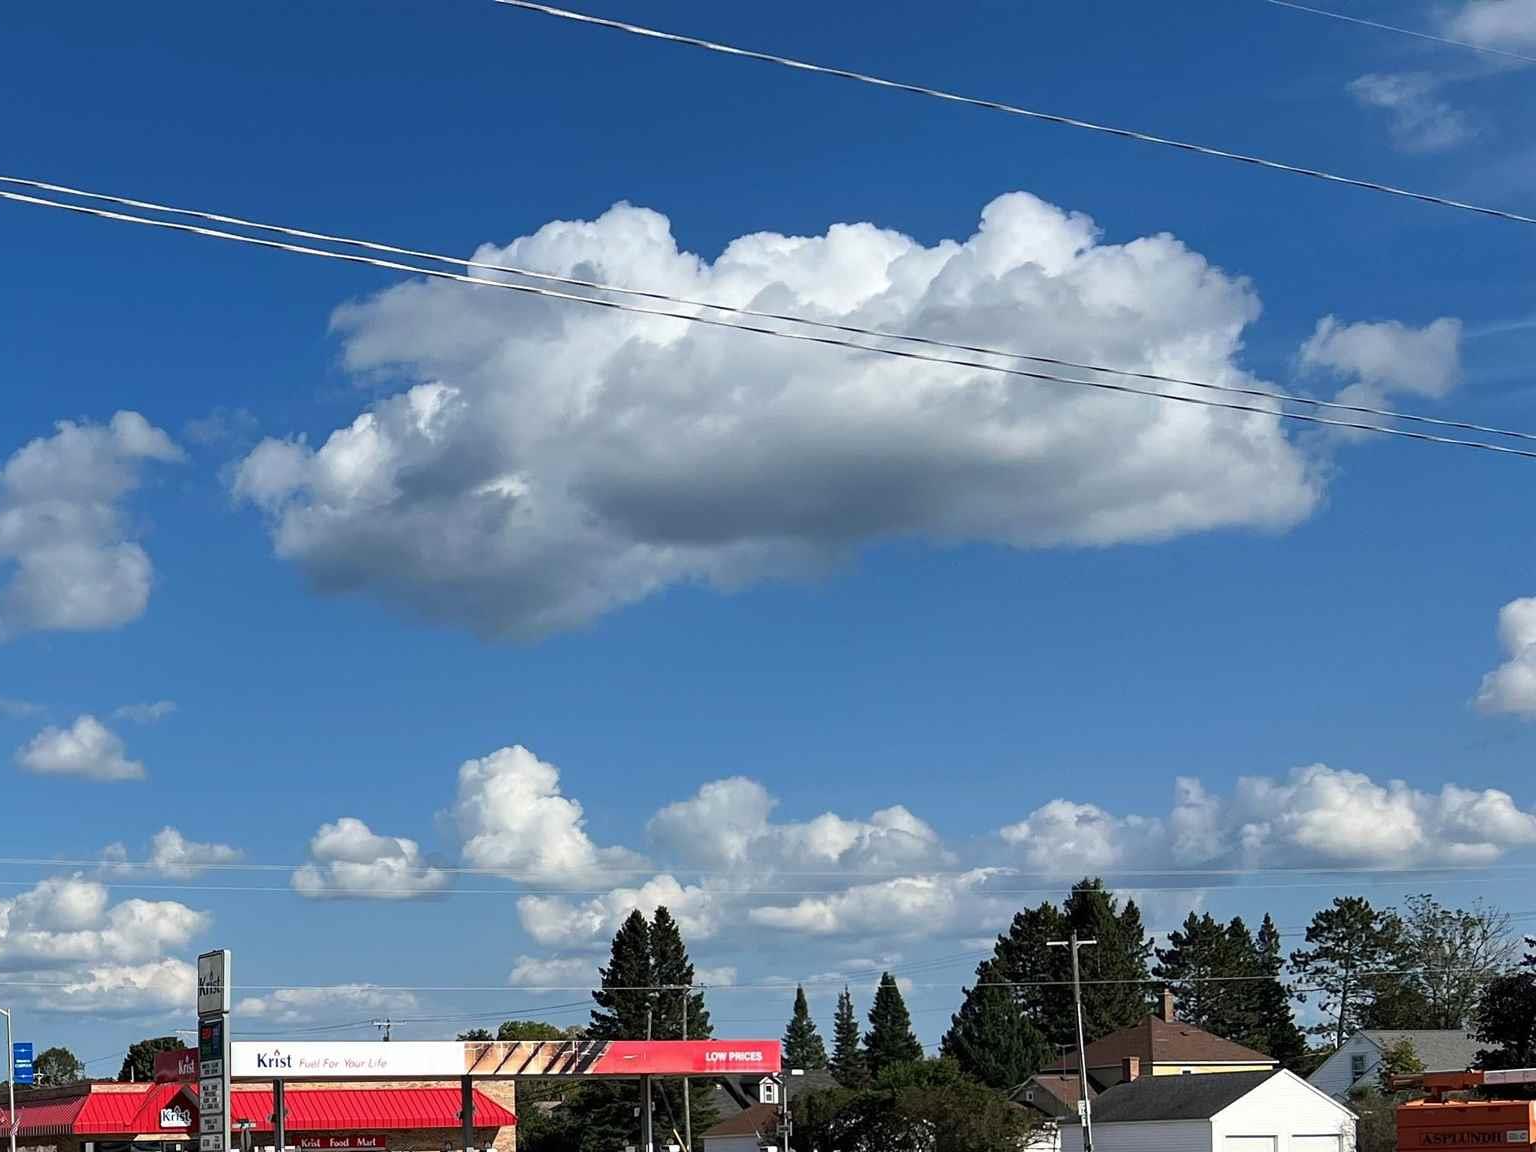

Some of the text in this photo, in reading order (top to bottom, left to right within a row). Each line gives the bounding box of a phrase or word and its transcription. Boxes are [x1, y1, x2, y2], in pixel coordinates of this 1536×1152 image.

[199, 976, 221, 996] Krist
[257, 1052, 388, 1069] Krist Fuel For Your Life
[705, 1051, 763, 1062] LOW PRICES
[178, 1059, 194, 1075] Krist
[162, 1109, 192, 1122] Krist
[301, 1137, 376, 1148] Krist Food Mart
